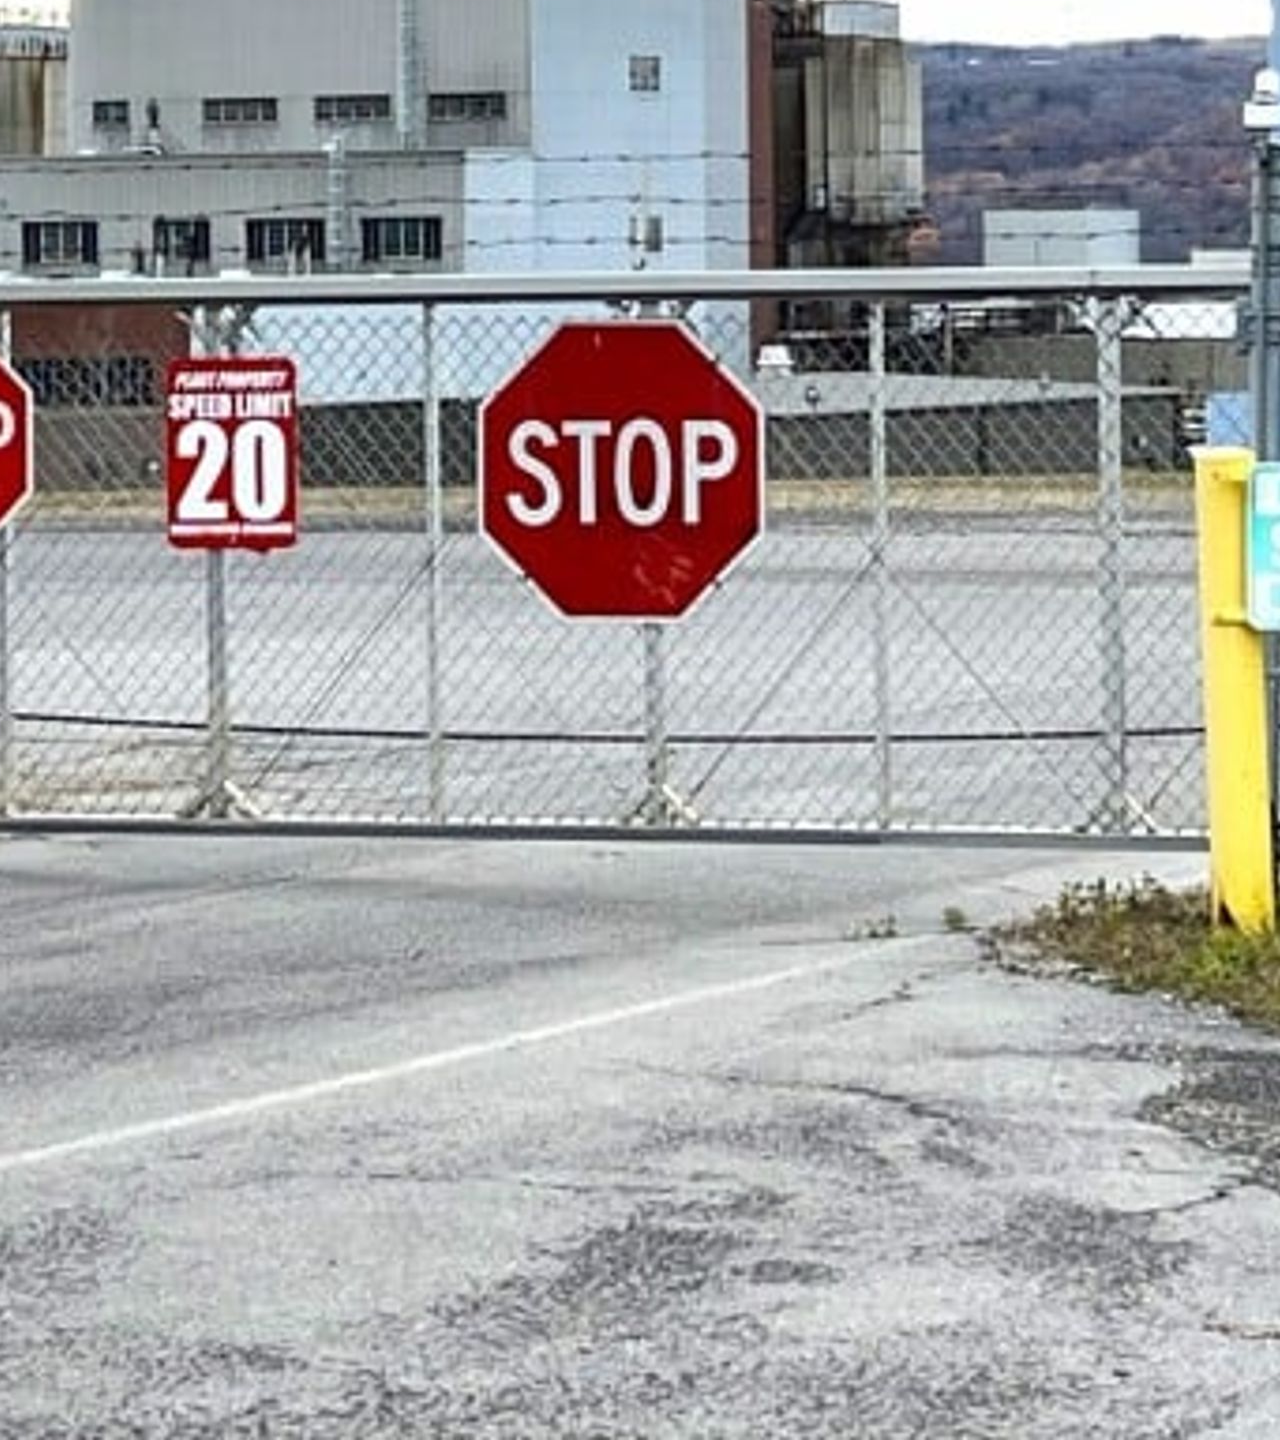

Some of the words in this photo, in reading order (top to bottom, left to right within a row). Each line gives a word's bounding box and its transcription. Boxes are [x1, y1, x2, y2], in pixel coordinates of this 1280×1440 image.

[168, 393, 232, 420] SPEED
[235, 392, 293, 419] LIMIT
[176, 420, 288, 522] 20
[505, 416, 740, 528] STOP
